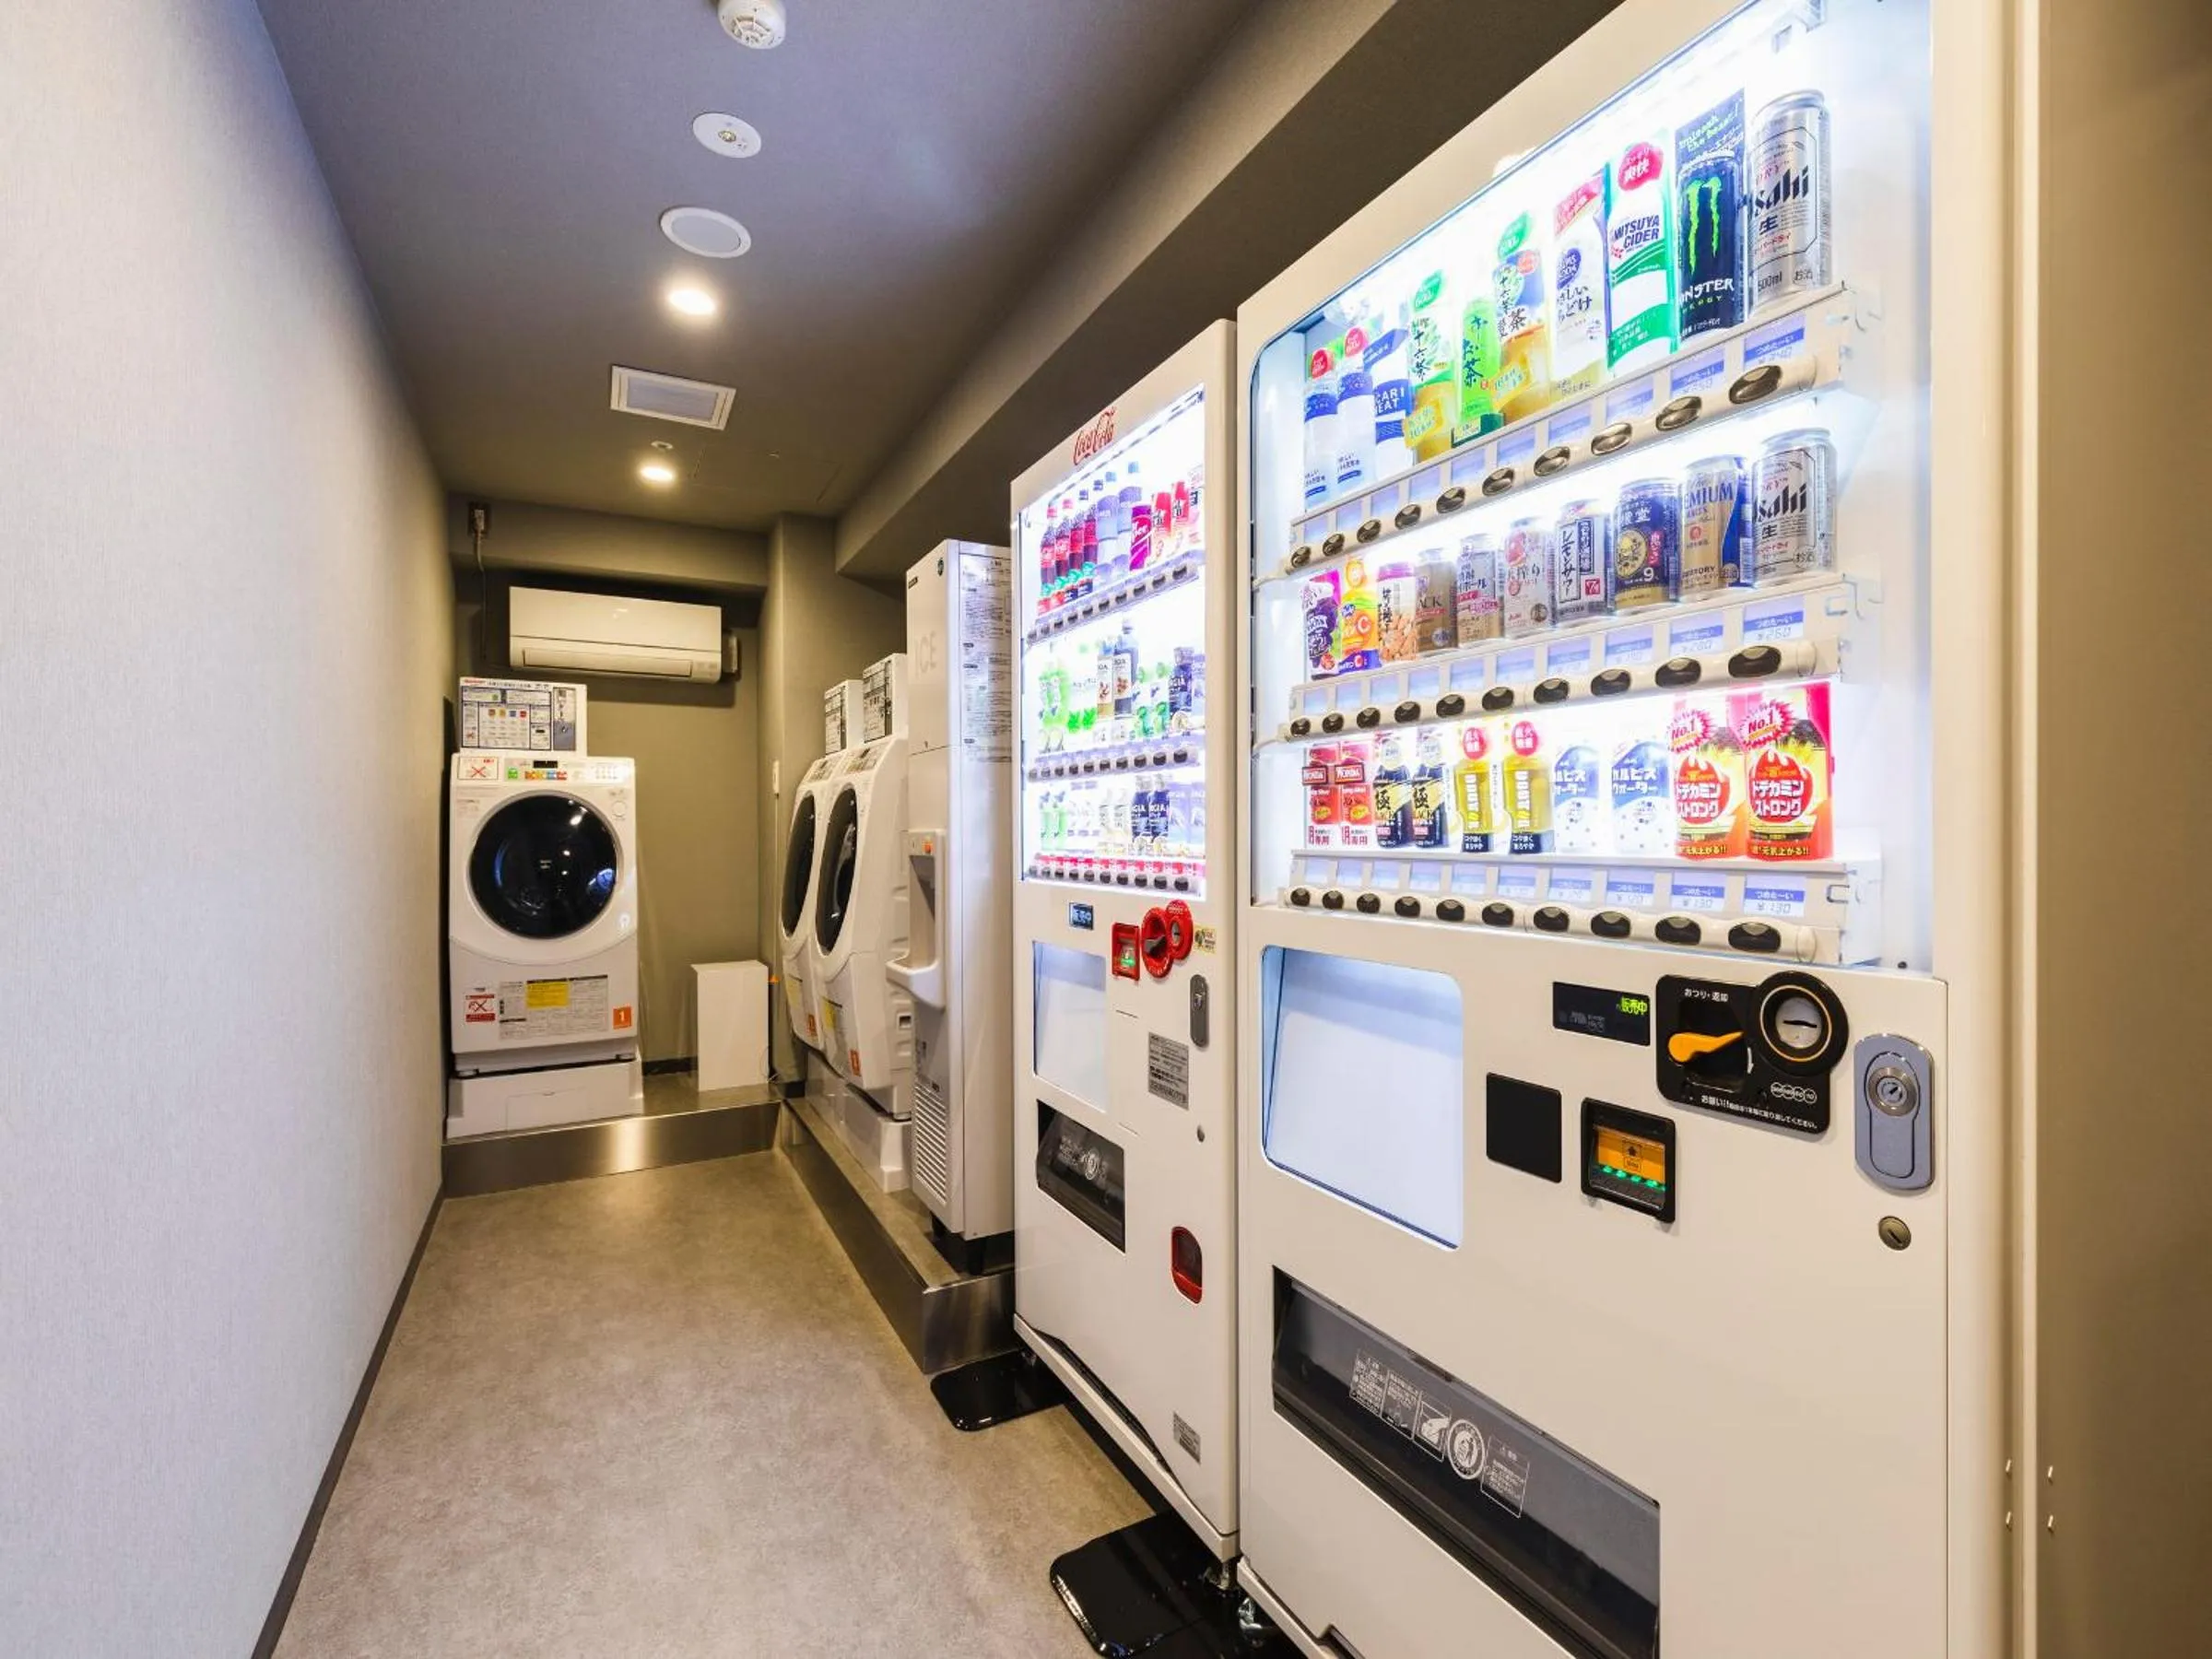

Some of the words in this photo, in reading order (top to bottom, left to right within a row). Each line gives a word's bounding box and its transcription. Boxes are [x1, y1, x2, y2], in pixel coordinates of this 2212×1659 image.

[1759, 214, 1779, 236] 生
[1623, 228, 1661, 250] CIDER
[1671, 718, 1695, 739] No.1
[1748, 711, 1774, 733] No.1
[1556, 768, 1587, 783] ルピス
[1753, 780, 1804, 798] ドデカミン
[1754, 798, 1802, 817] ストロング
[618, 1011, 625, 1022] 1
